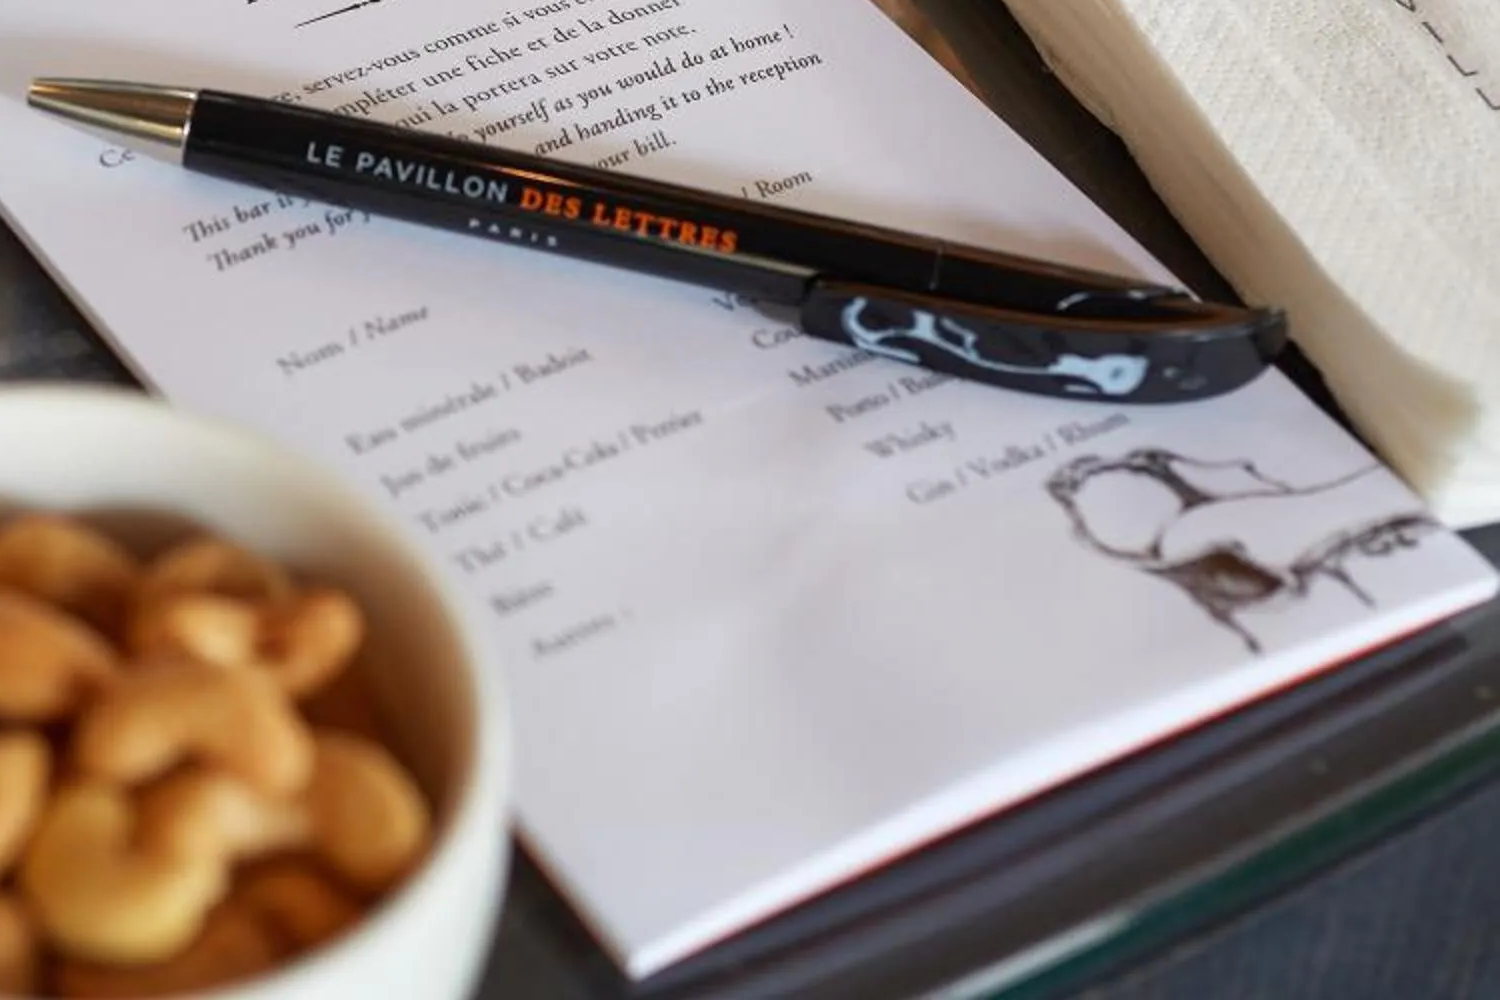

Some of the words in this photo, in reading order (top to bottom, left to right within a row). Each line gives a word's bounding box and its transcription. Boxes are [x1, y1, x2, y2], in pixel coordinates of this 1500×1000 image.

[303, 48, 422, 95] servez-vous
[424, 21, 501, 55] comme
[502, 11, 522, 29] si
[333, 80, 418, 116] mpléter
[422, 65, 464, 88] une
[464, 45, 523, 73] fiche
[526, 38, 550, 53] et
[552, 24, 579, 45] de
[578, 18, 606, 35] la
[431, 100, 460, 117] la
[462, 72, 543, 112] portera
[544, 58, 581, 80] sur
[582, 40, 641, 65] votre
[642, 24, 698, 48] note.
[473, 98, 551, 143] yourself
[553, 97, 575, 113] as
[576, 83, 614, 109] you
[615, 57, 678, 91] would
[680, 51, 706, 71] do
[708, 46, 731, 61] at
[732, 28, 784, 54] home
[534, 134, 575, 158] and
[574, 104, 664, 142] handing
[662, 94, 680, 112] it
[681, 87, 703, 104] to
[704, 76, 736, 98] the
[737, 50, 824, 87] reception
[593, 148, 630, 171] our
[632, 128, 678, 159] bill.
[753, 170, 814, 200] Room
[183, 215, 232, 244] This
[232, 202, 273, 226] bar
[305, 140, 346, 170] LE
[355, 150, 510, 203] PAVILLON
[519, 187, 581, 221] DES
[592, 202, 740, 255] LETTRES
[467, 217, 560, 248] PARIS
[207, 231, 280, 273] Thank
[281, 221, 322, 250] you
[324, 209, 353, 237] for
[276, 341, 346, 377] Nom
[363, 304, 429, 341] Name
[512, 347, 594, 385] Badoit
